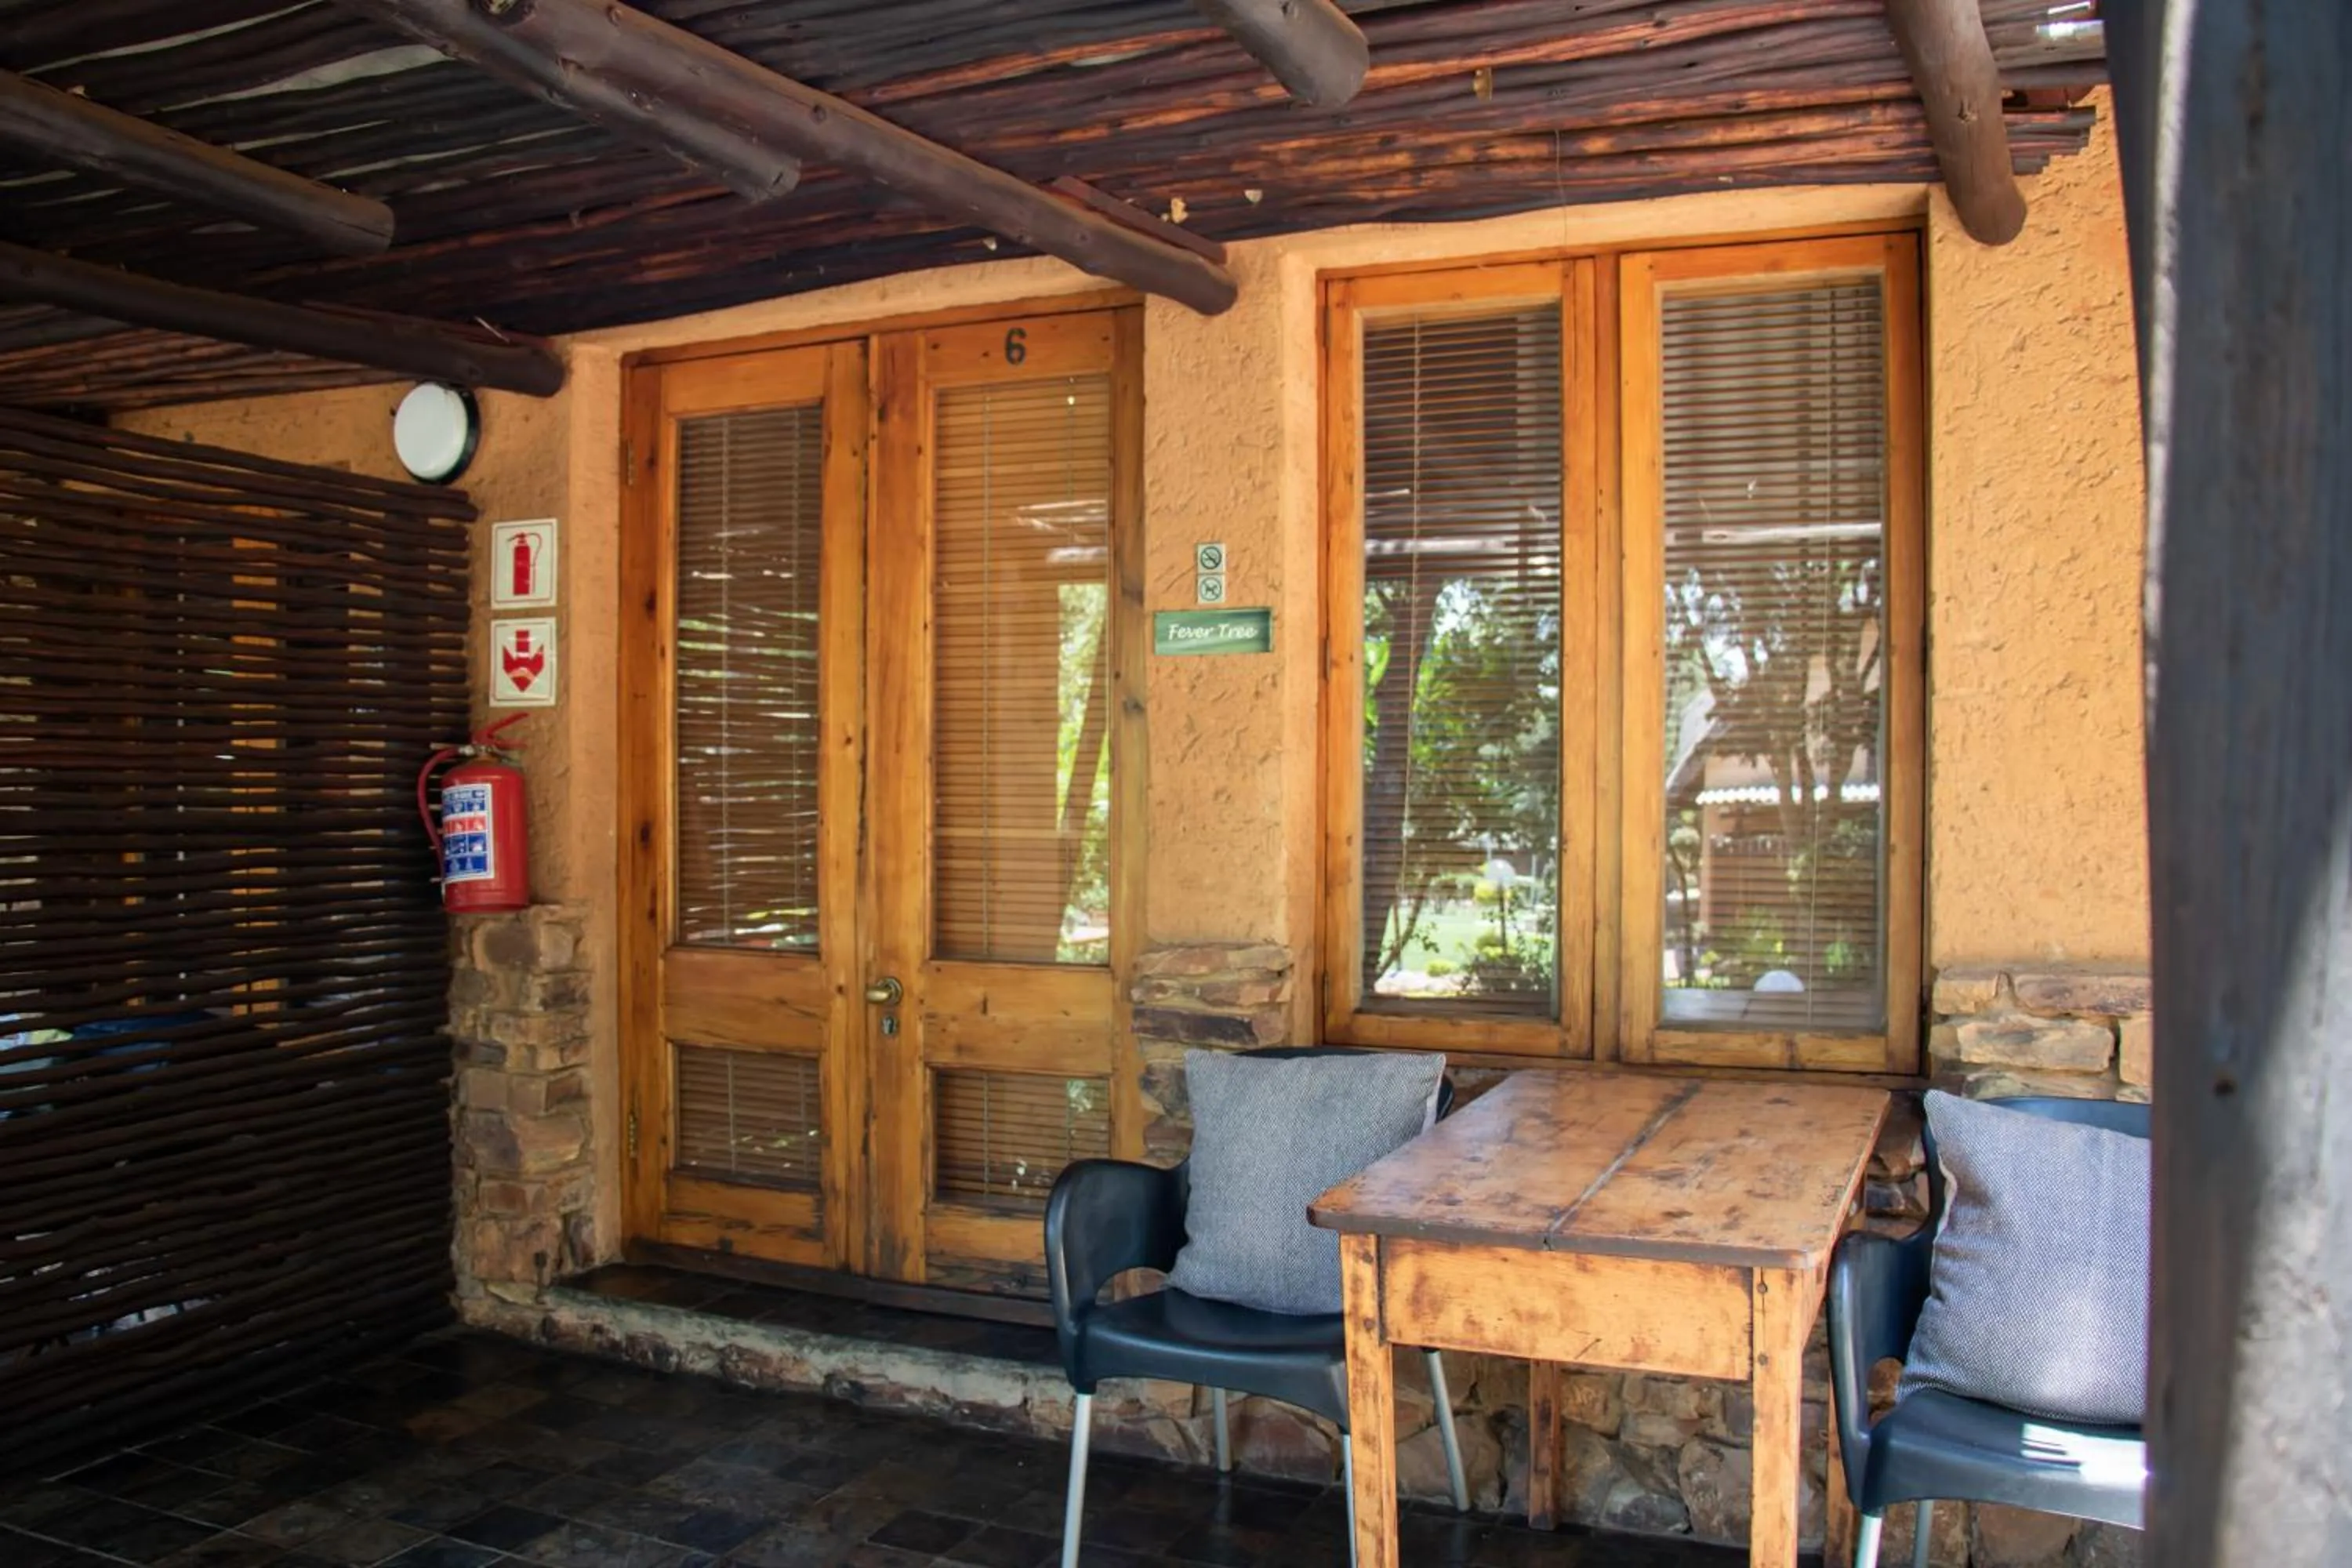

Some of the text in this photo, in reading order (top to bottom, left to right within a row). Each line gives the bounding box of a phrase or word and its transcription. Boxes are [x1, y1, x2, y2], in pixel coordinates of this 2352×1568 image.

[1005, 327, 1027, 366] 6
[1168, 622, 1259, 641] Fever Tree
